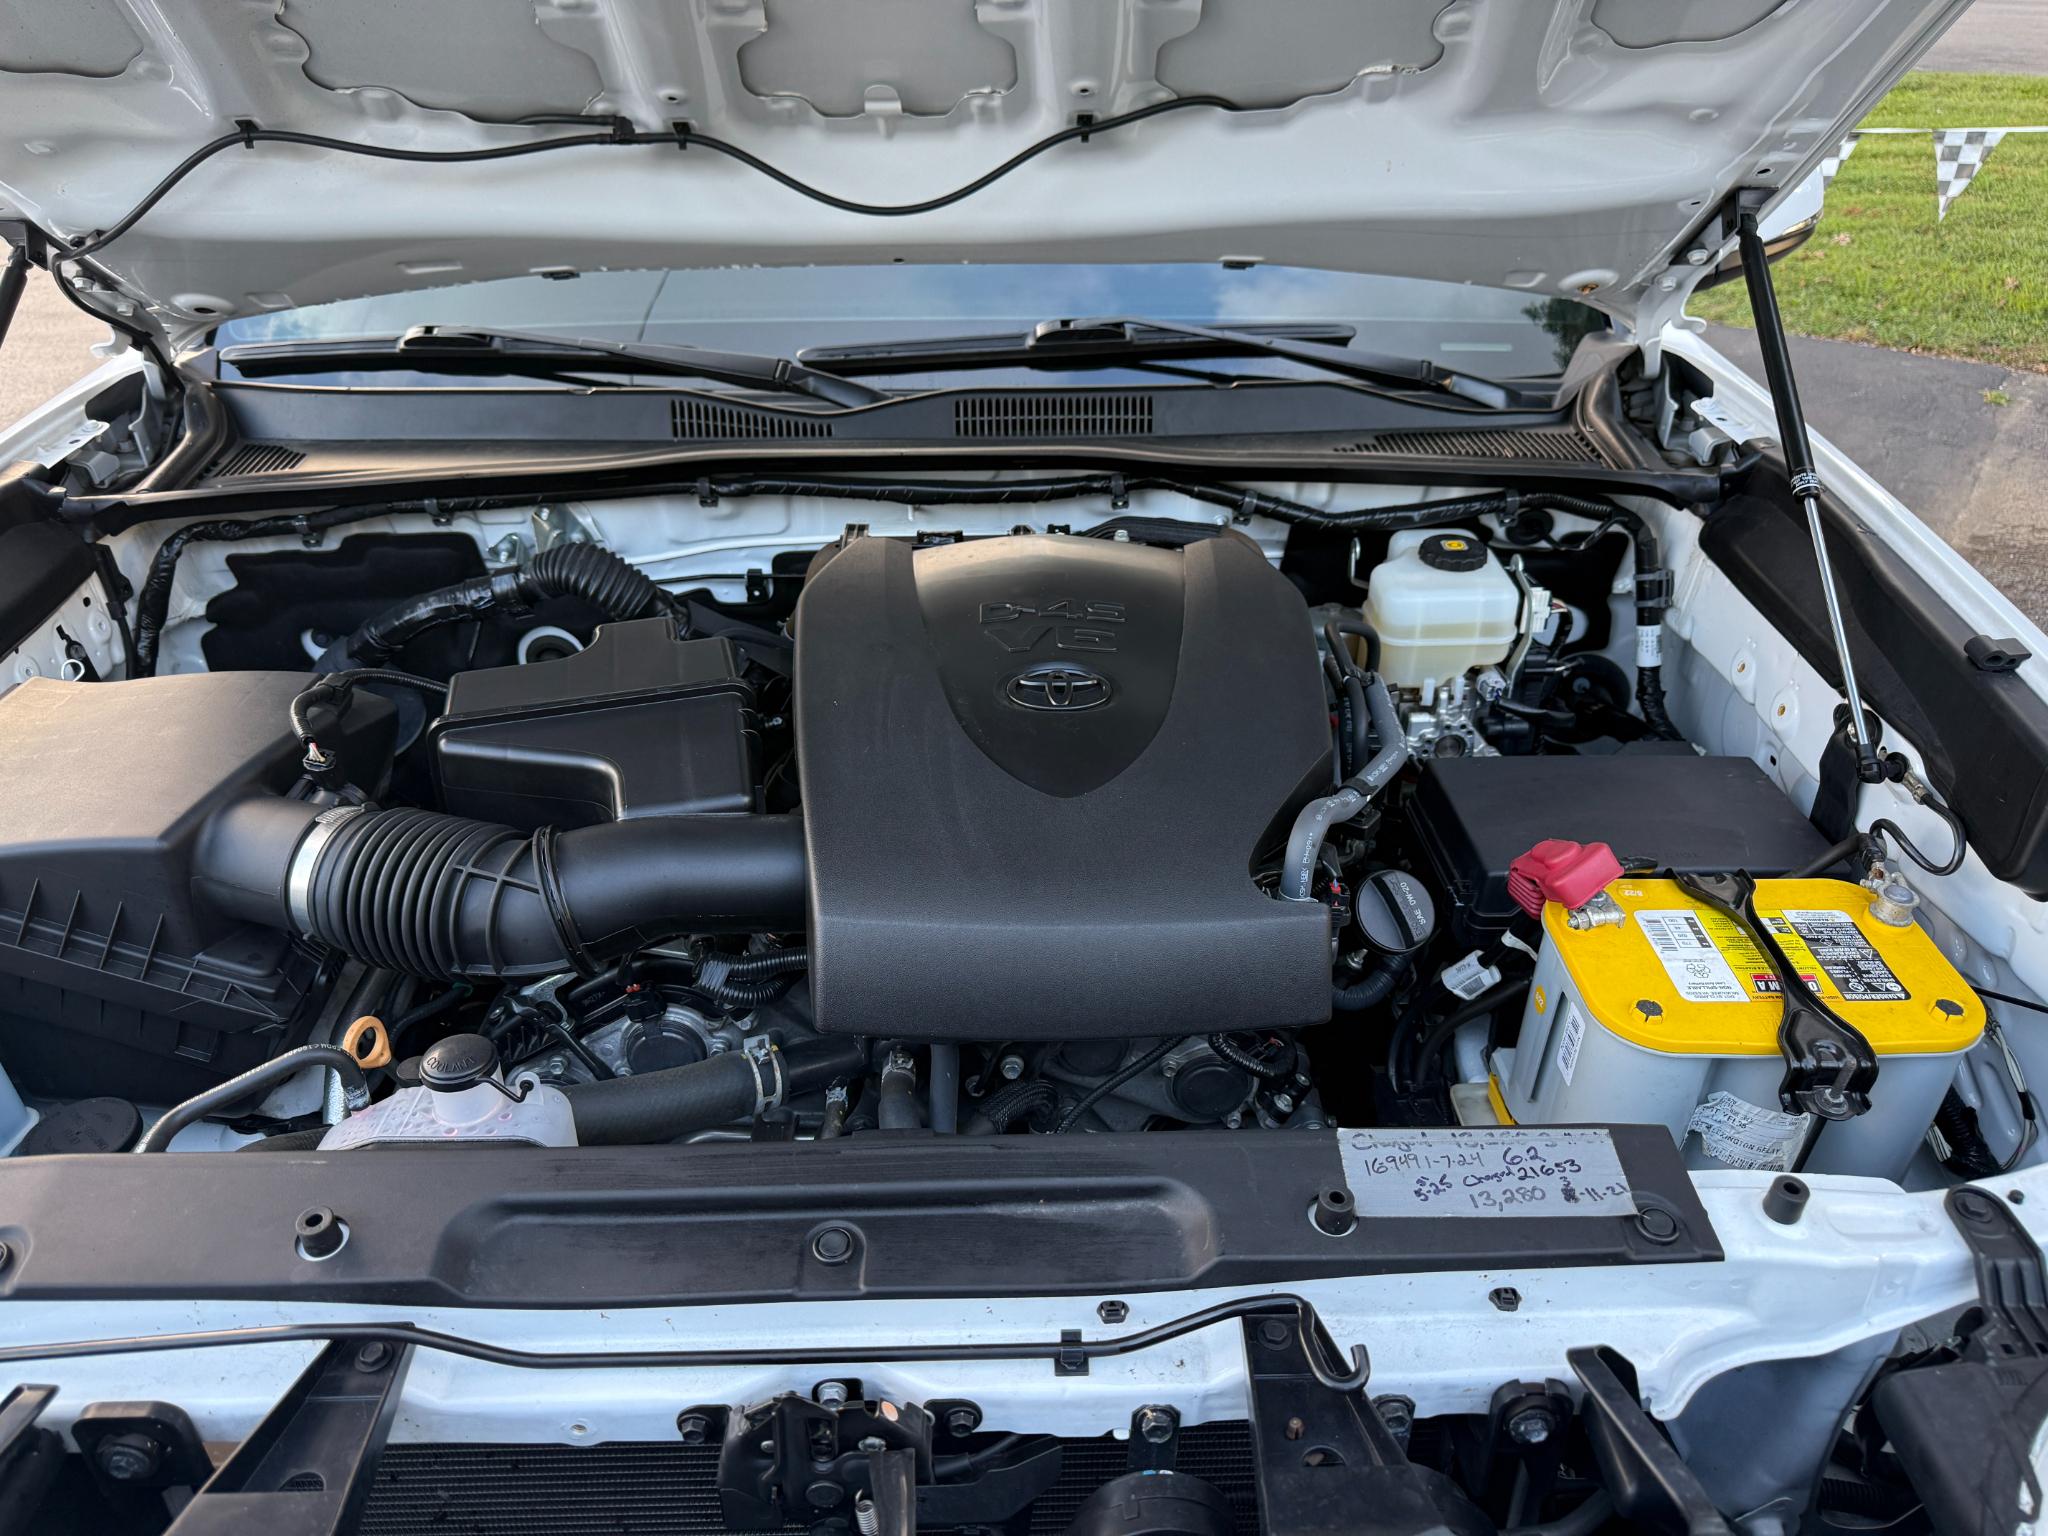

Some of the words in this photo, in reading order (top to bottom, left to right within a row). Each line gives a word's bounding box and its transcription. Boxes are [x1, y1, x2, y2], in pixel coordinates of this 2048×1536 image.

[1400, 882, 1416, 906] 0W-20
[1413, 908, 1426, 925] SAE
[426, 1056, 475, 1073] COOLANT
[1517, 1158, 1582, 1181] 21653
[1468, 1185, 1547, 1213] 13,280
